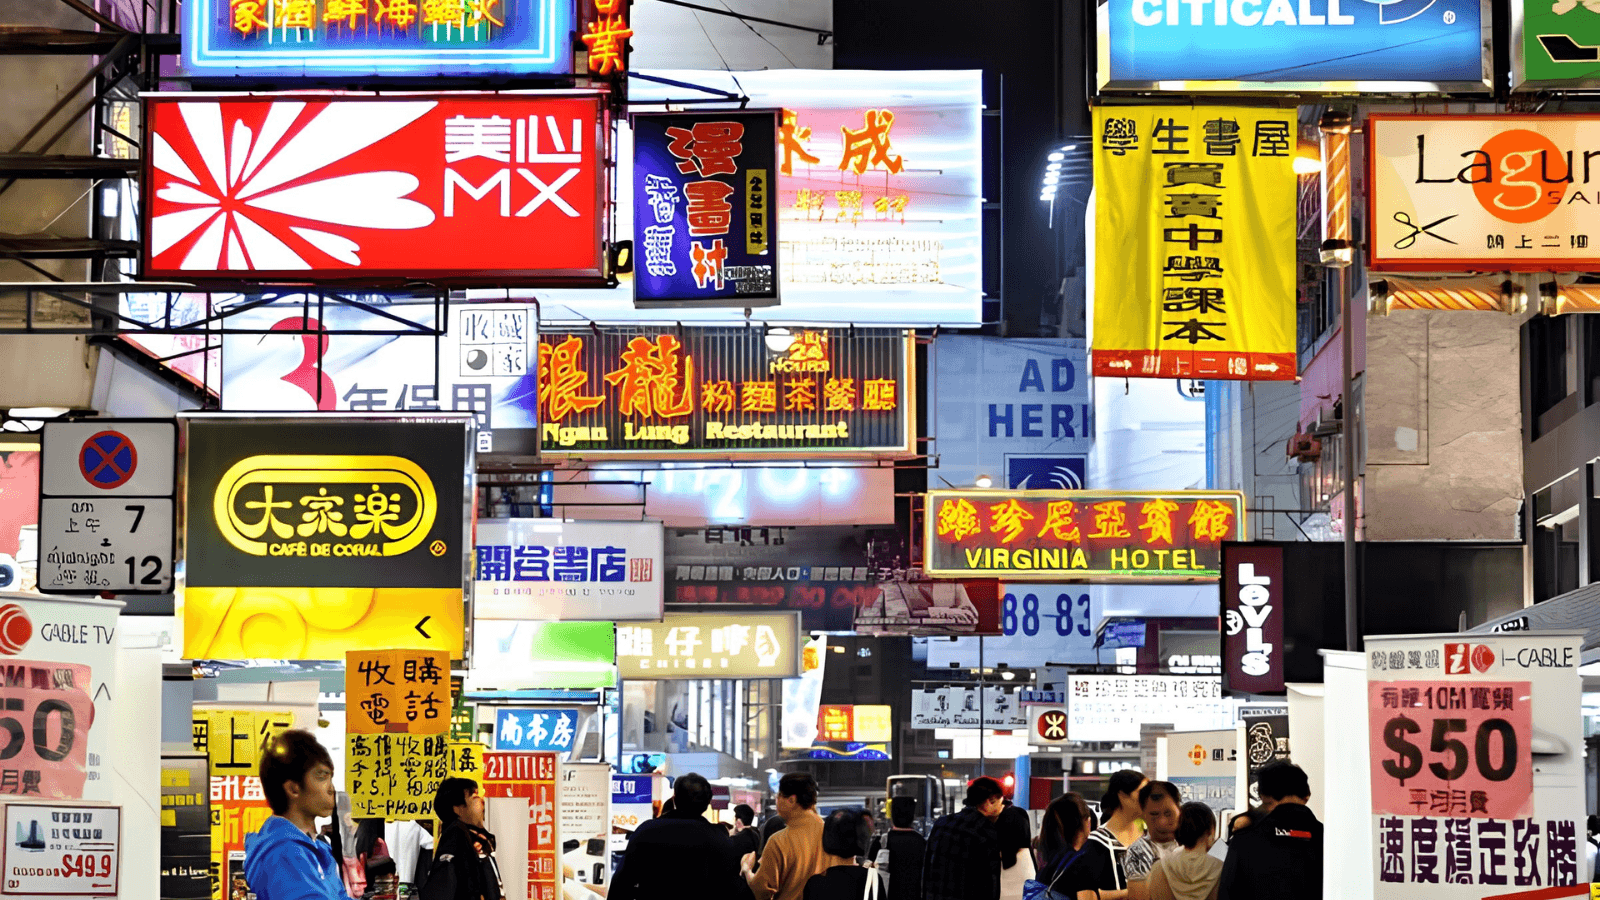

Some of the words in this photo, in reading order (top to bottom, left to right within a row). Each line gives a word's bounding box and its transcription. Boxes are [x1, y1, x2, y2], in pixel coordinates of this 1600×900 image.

[1131, 0, 1354, 26] CITICALL
[445, 115, 582, 164] 美心
[1102, 116, 1290, 157] 學生書屋
[443, 168, 581, 217] MX
[1547, 190, 1600, 205] SA
[1162, 161, 1228, 345] 買賣中學課本
[1018, 358, 1075, 393] AD
[542, 422, 608, 446] Ngan
[624, 421, 690, 445] Lung
[706, 420, 849, 440] Restaurant
[124, 505, 145, 533] 7
[310, 542, 331, 556] DE
[965, 547, 1088, 570] VIRGINIA
[1110, 548, 1205, 570] HOTEL
[124, 555, 163, 585] 12
[92, 625, 115, 644] TV
[358, 657, 443, 687] 收購
[360, 690, 444, 726] 電話
[1381, 713, 1519, 787] $50
